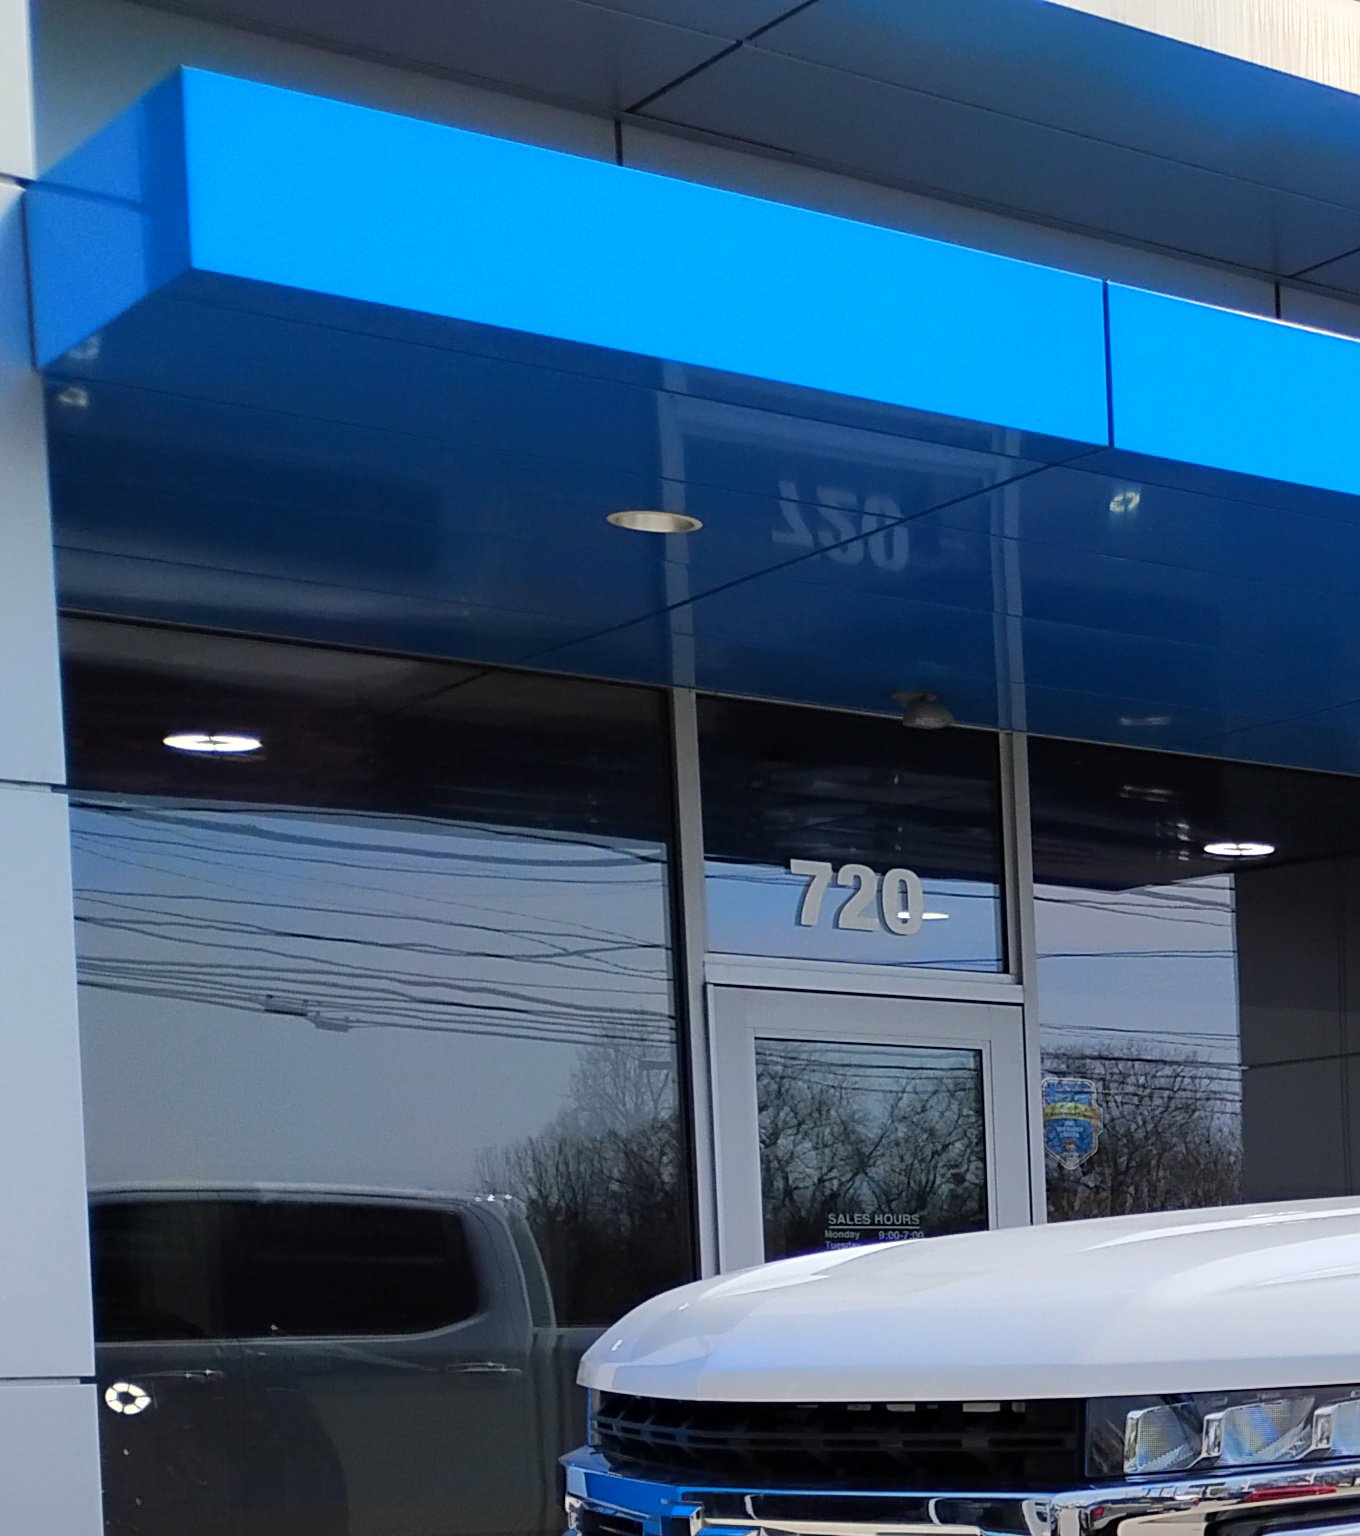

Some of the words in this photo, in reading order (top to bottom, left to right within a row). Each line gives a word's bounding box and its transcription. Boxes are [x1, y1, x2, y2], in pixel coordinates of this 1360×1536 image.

[790, 858, 924, 935] 720
[828, 1213, 871, 1225] SALES
[874, 1213, 921, 1225] HOURS
[824, 1229, 860, 1240] Monday
[878, 1230, 924, 1240] 9:00-7:00
